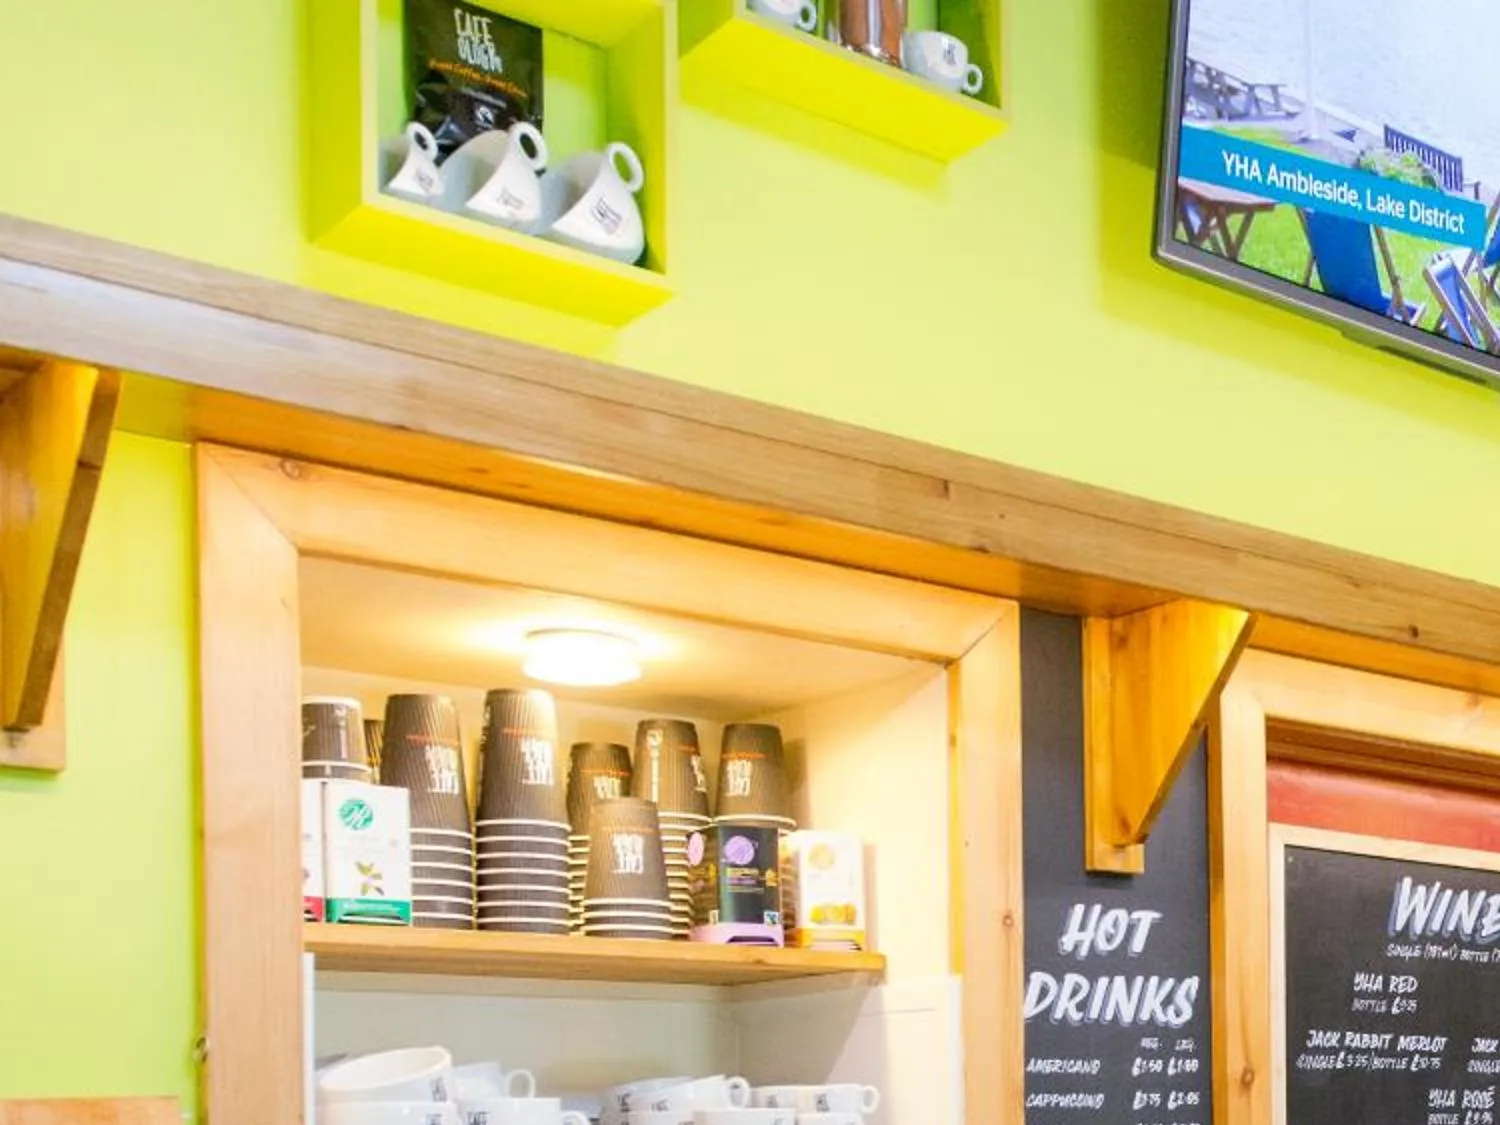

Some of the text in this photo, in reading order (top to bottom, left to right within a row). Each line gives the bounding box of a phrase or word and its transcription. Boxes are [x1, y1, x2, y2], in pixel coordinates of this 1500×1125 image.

[1221, 149, 1466, 235] YHA Ambleside, Lake District
[1058, 903, 1163, 961] HOT
[1389, 975, 1418, 993] RED
[1022, 971, 1200, 1028] DRINKS
[1306, 1030, 1449, 1053] JACK RABBIT MERLOT
[1472, 1037, 1499, 1054] JACK
[1026, 1058, 1101, 1075] AMERICANO
[1026, 1093, 1105, 1110] CAPPUCCINO
